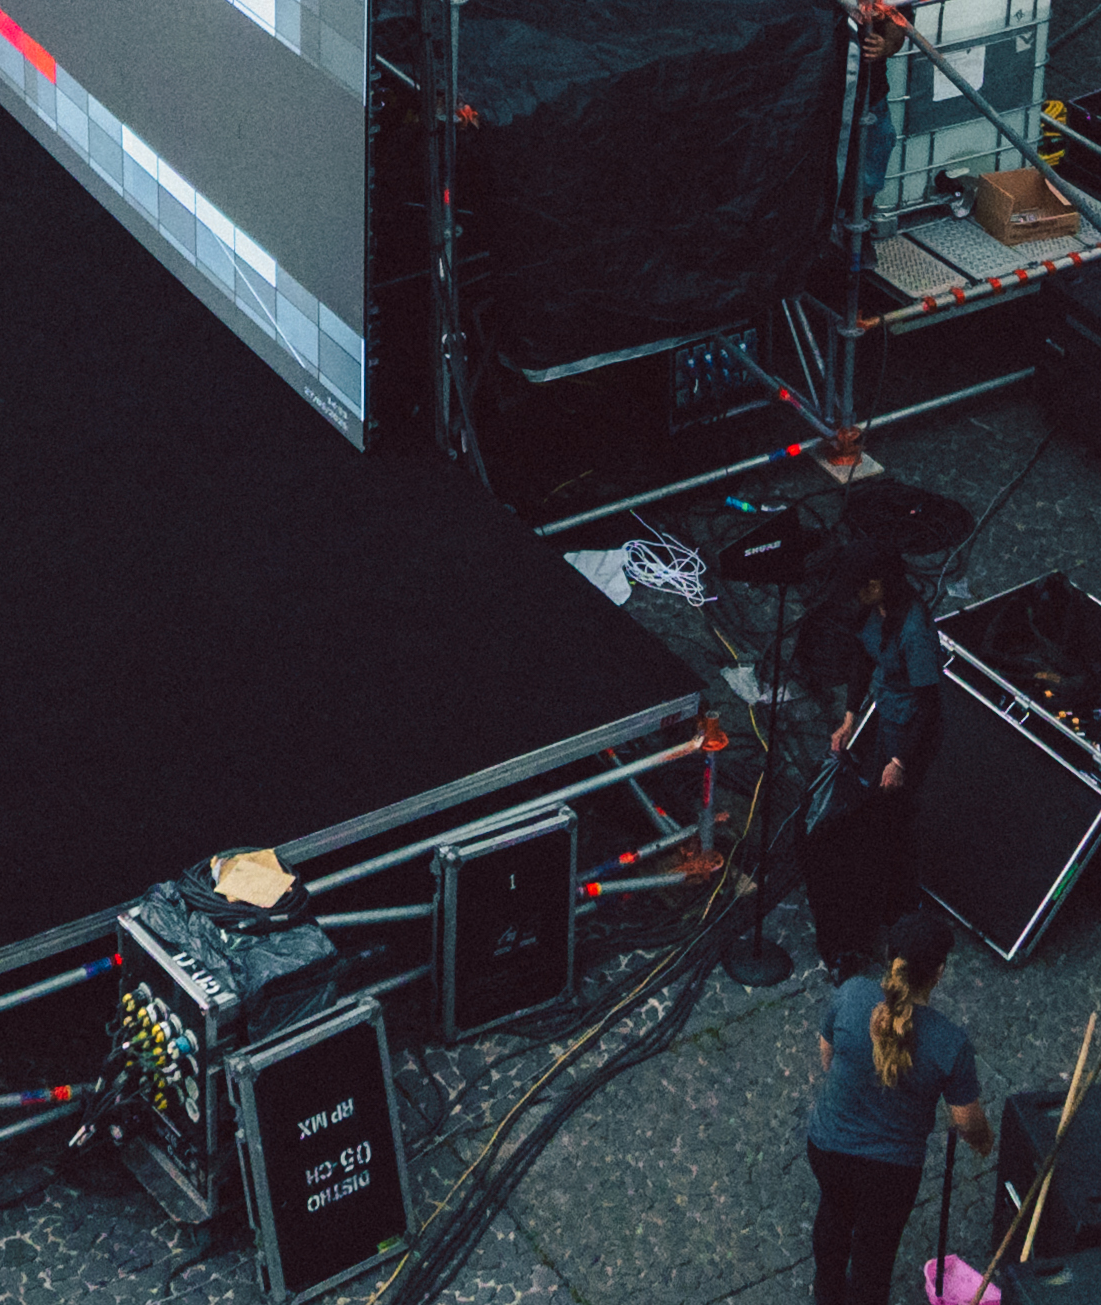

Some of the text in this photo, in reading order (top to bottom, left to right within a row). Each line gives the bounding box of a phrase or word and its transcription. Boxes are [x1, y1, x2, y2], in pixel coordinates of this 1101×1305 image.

[744, 540, 782, 557] SHURE
[297, 1097, 354, 1140] RP MX
